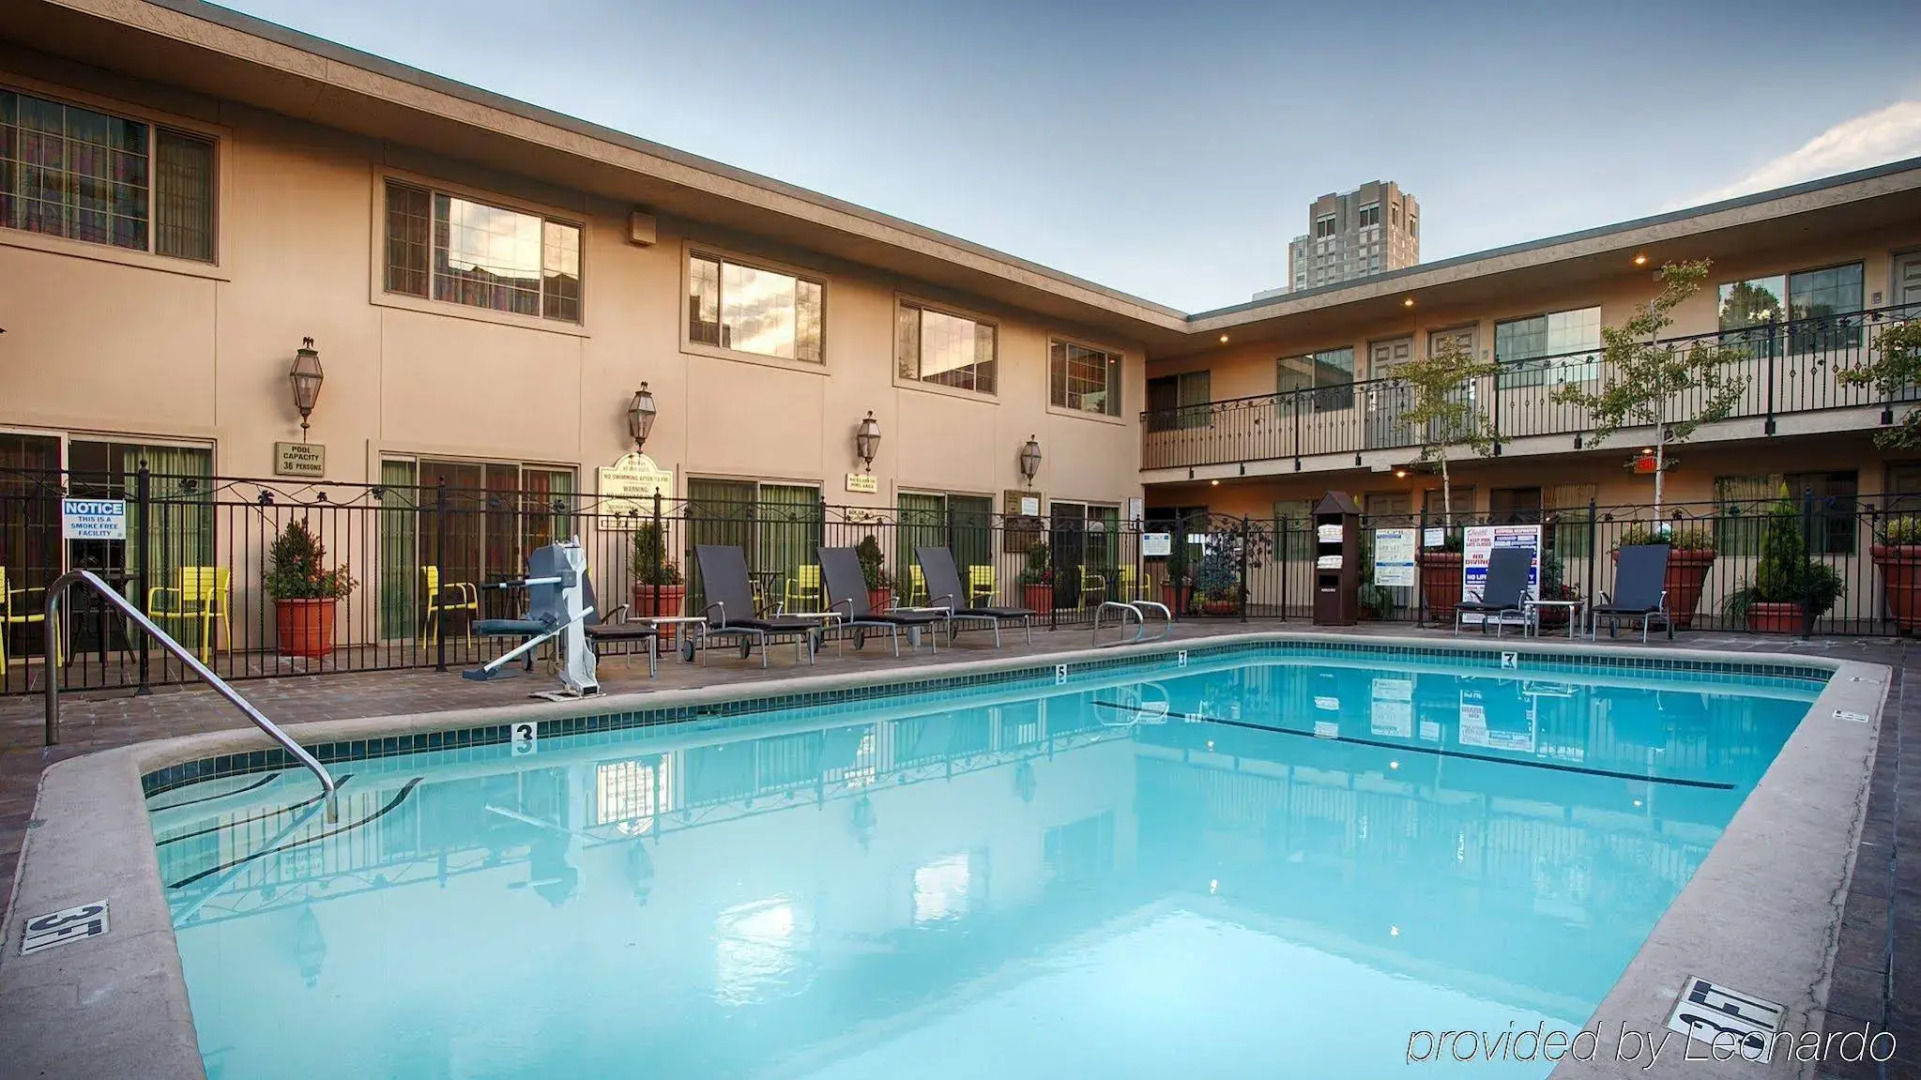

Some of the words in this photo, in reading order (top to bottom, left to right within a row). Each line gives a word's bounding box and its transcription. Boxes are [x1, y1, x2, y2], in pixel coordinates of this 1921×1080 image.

[283, 453, 319, 461] CAPACITY
[283, 461, 293, 470] 36
[65, 502, 123, 515] NOTICE
[516, 724, 533, 740] 3
